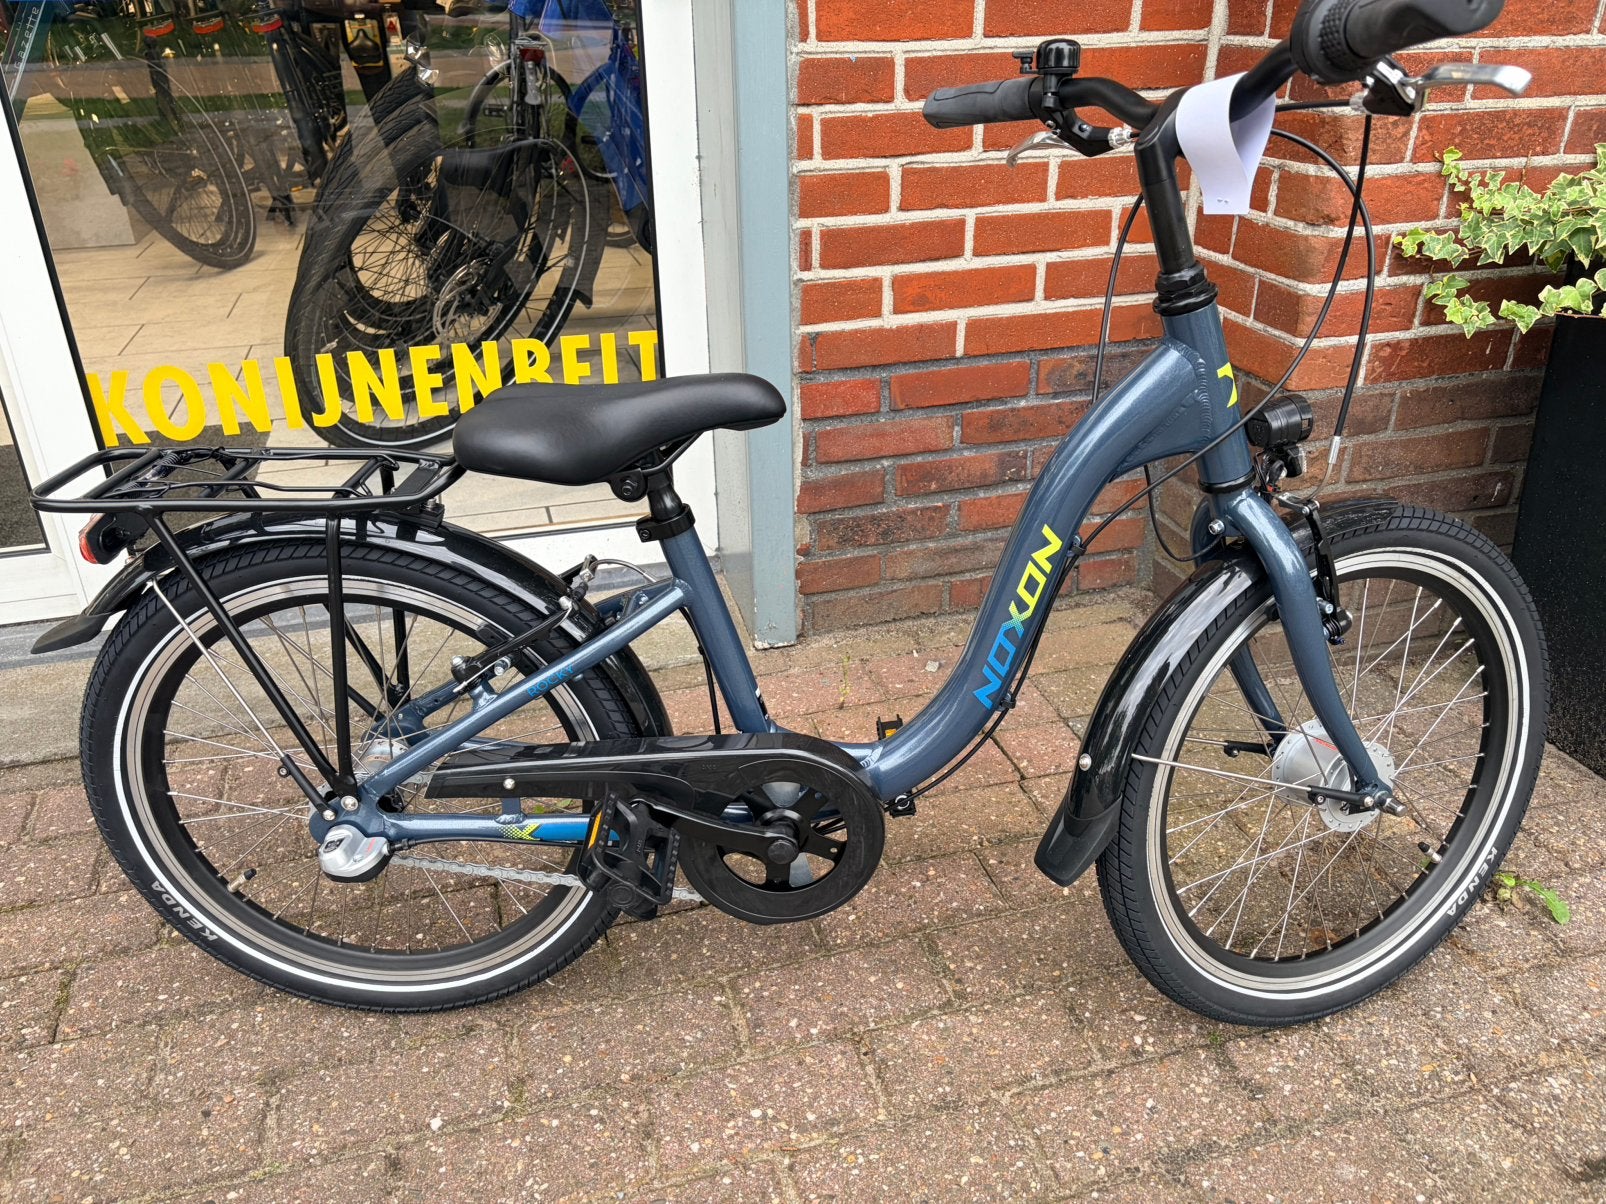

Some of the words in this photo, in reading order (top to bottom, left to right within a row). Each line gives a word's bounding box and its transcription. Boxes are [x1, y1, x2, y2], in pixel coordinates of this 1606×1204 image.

[973, 524, 1062, 709] NOXON
[527, 664, 574, 697] ROCKY
[151, 880, 218, 941] KENDA
[1447, 847, 1498, 916] KENDA
